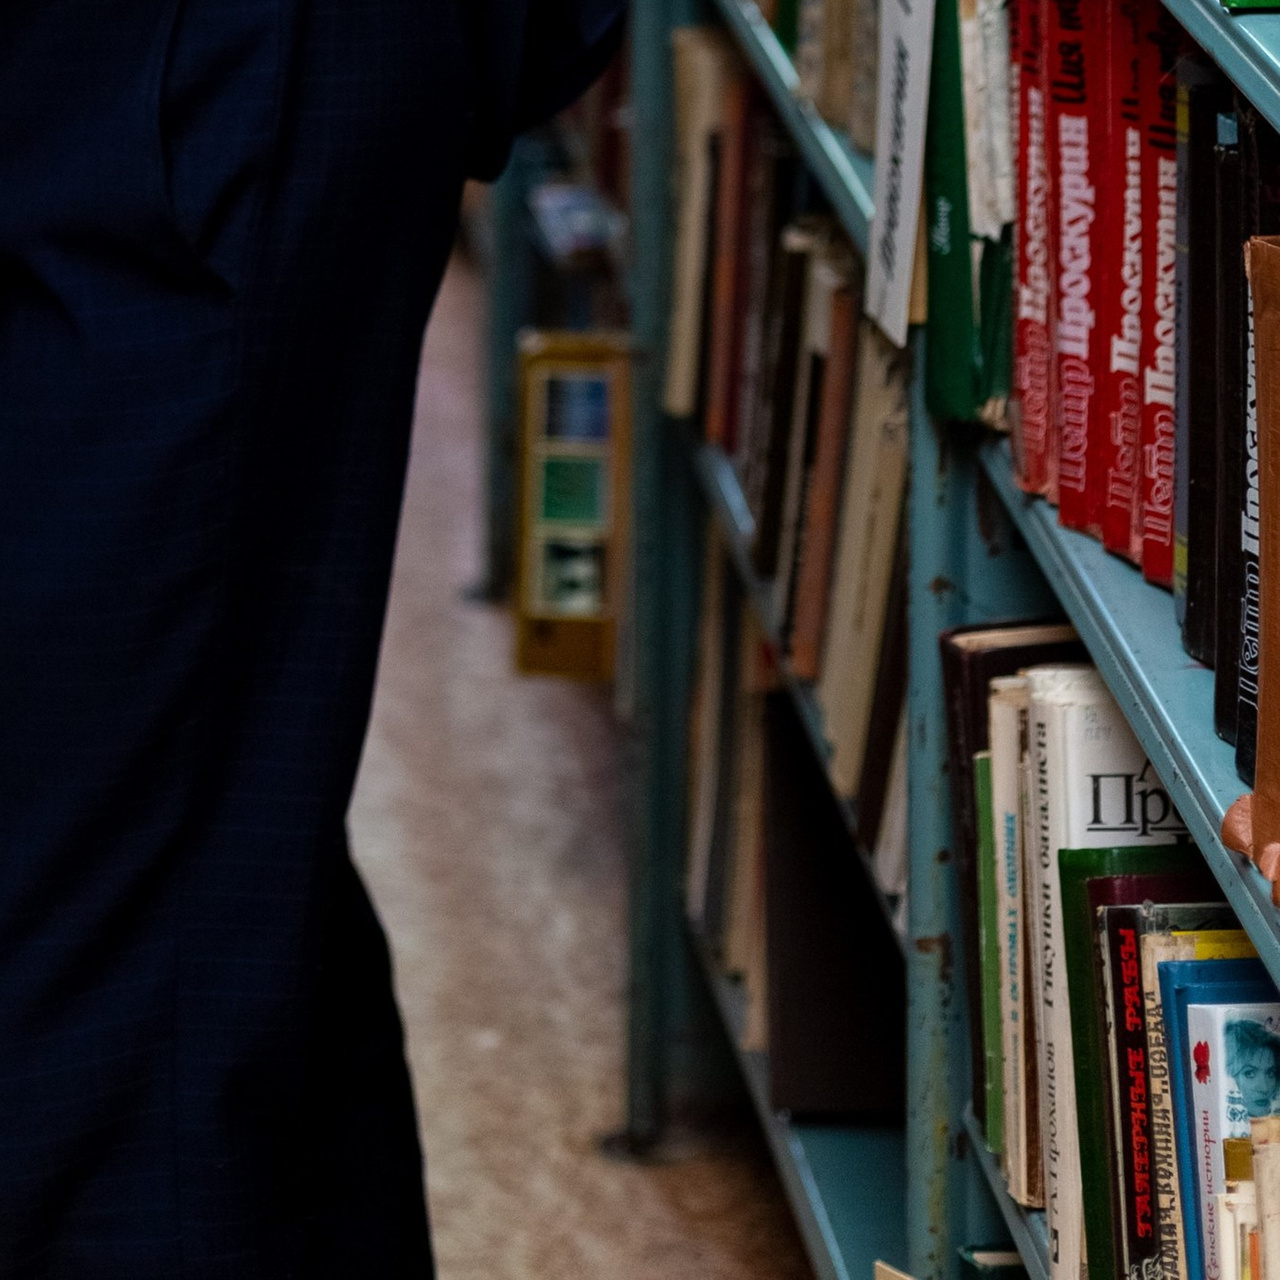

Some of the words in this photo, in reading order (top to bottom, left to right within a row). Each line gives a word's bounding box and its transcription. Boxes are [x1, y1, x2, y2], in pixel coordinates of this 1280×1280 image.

[1055, 113, 1096, 360] Проскурин
[1035, 721, 1051, 870] баталиста
[1085, 773, 1186, 838] Пр
[1041, 882, 1056, 1010] Рисунки
[1119, 928, 1142, 1032] РАБЫ
[1046, 1042, 1061, 1180] Проханов
[1126, 1047, 1153, 1238] ГАЛЕРНЫЕ
[1200, 1109, 1217, 1195] истории
